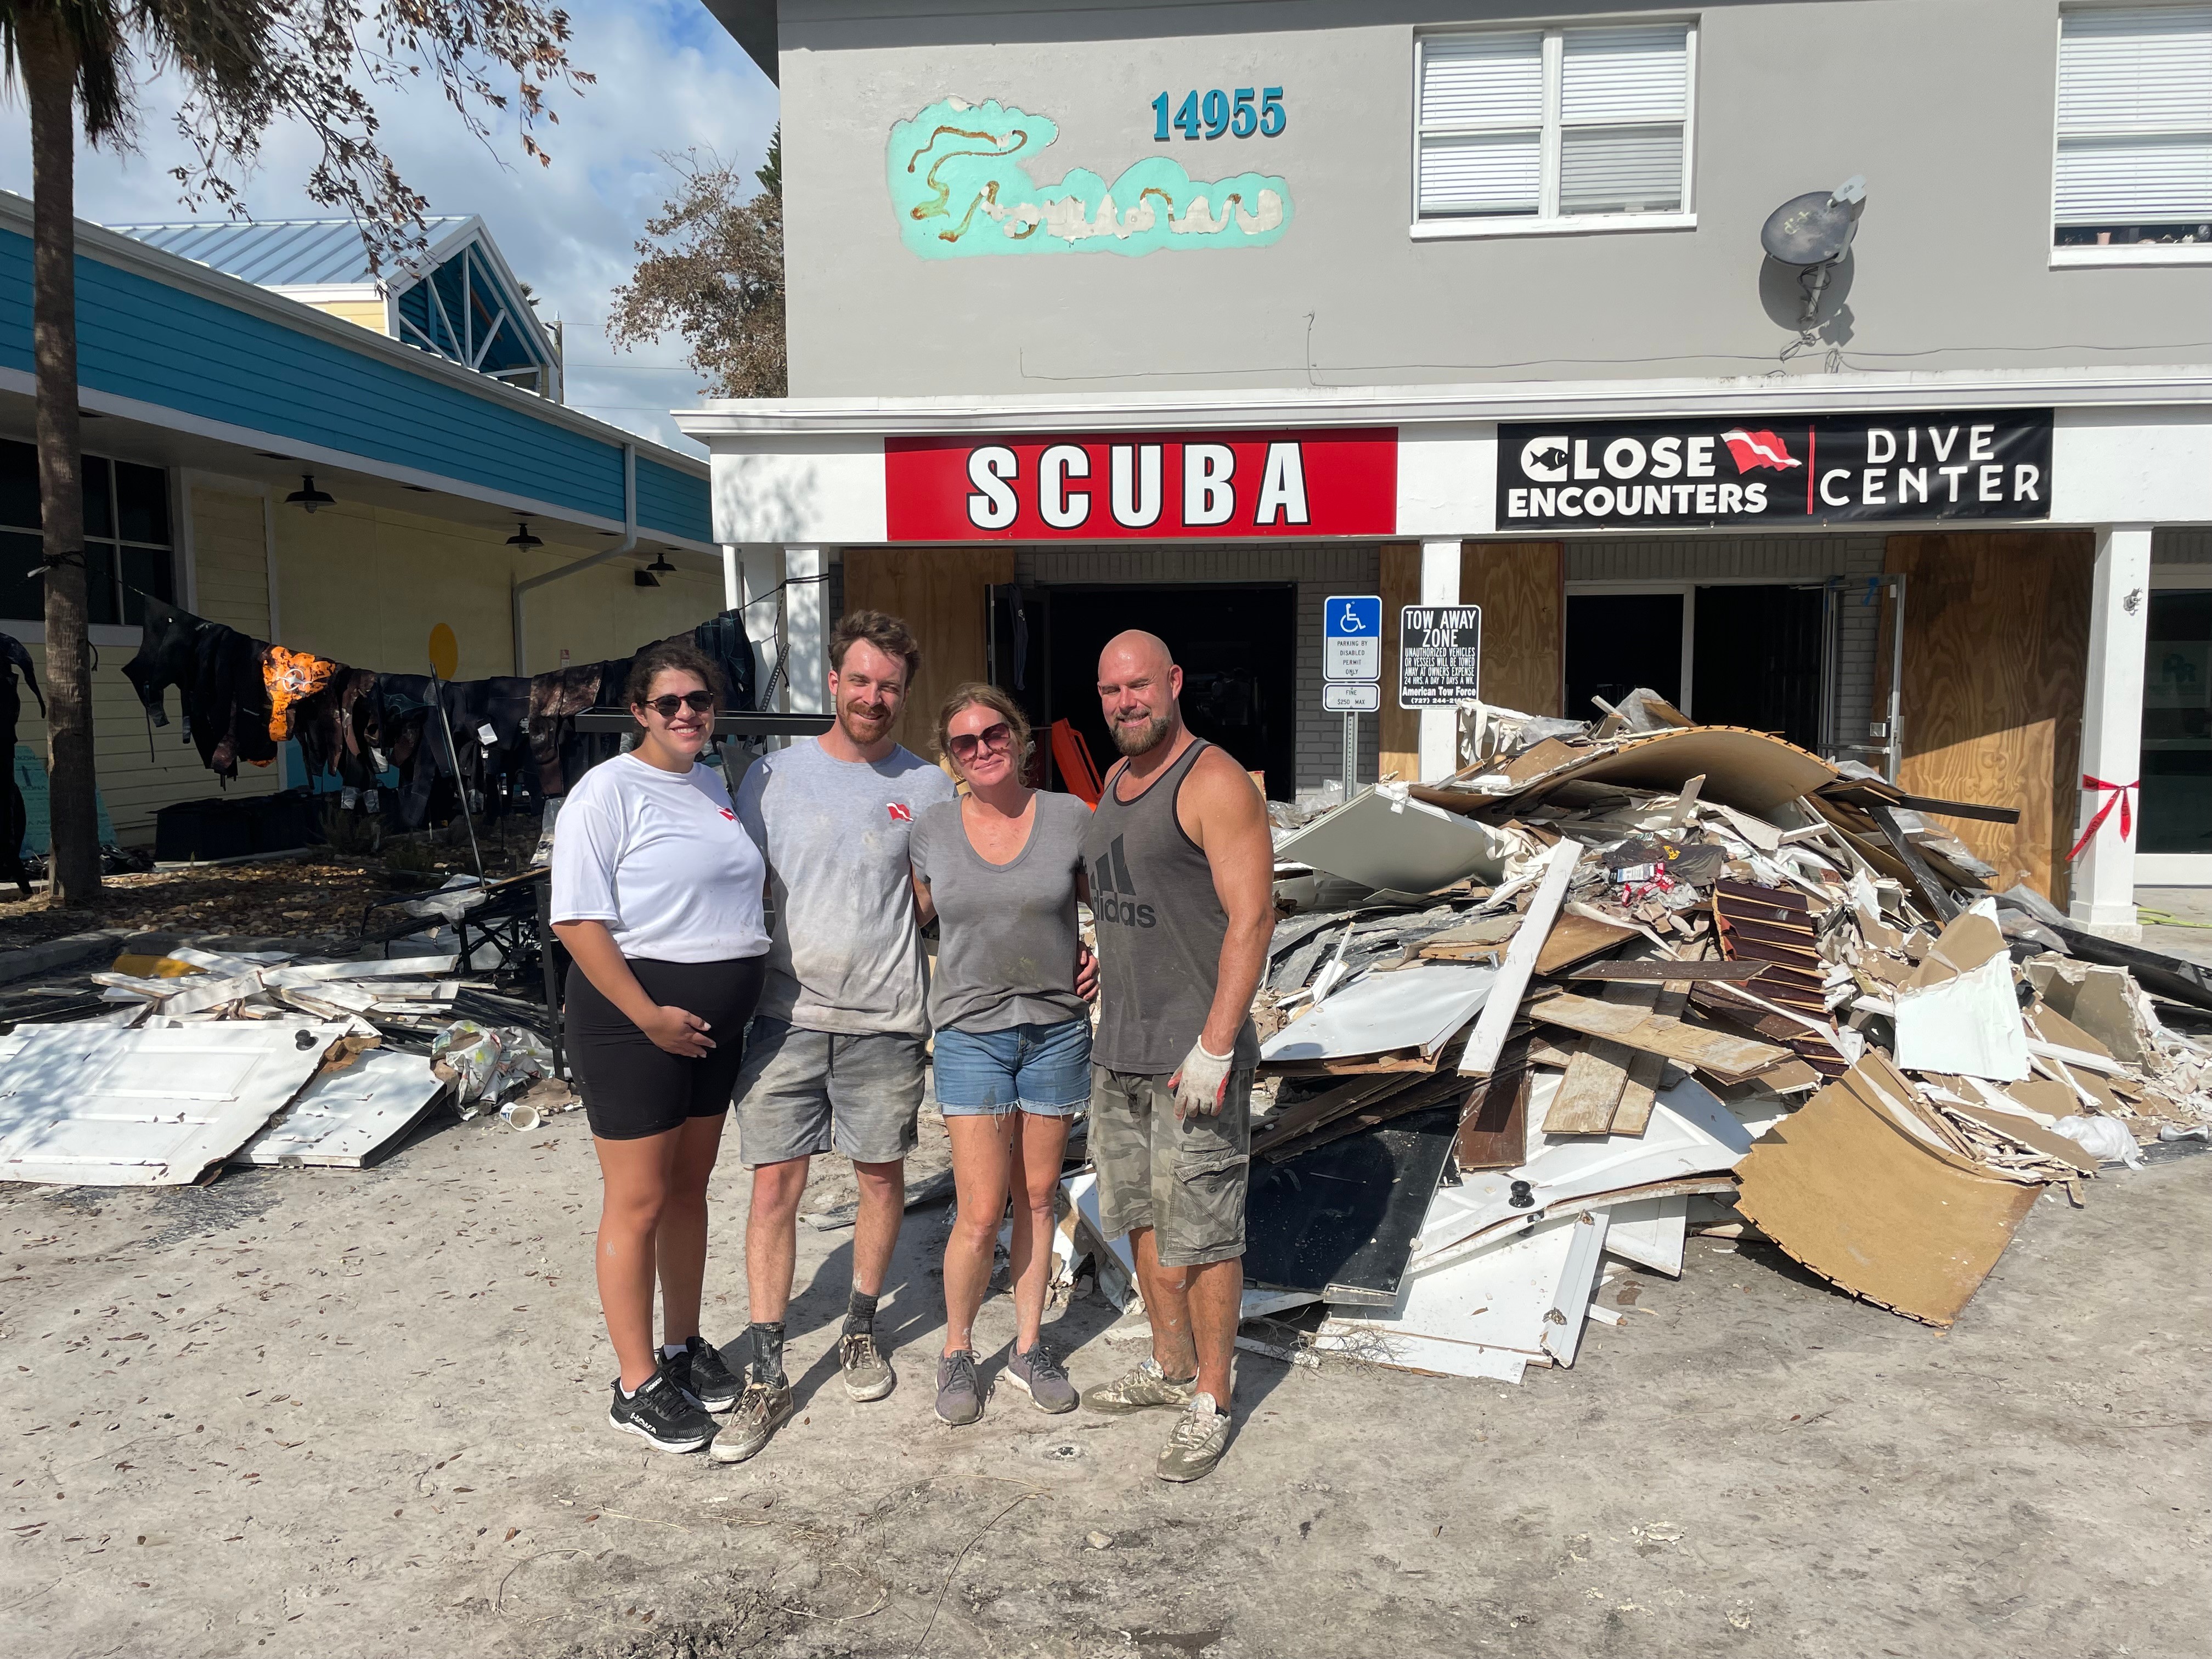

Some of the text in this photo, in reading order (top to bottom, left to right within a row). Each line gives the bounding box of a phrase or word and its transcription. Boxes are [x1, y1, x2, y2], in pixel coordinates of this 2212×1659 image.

[1151, 85, 1287, 142] 14955
[1866, 424, 1995, 464] DIVE
[1520, 435, 1716, 482] CLOSE
[966, 439, 1312, 531] SCUBA
[1819, 464, 2040, 506] CENTER
[1508, 483, 1768, 517] ENCOUNTERS
[1406, 610, 1476, 630] TOW AWAY
[1422, 628, 1458, 647] ZONE
[1404, 647, 1475, 657] UNAUTHORIZED VEHICLES
[1404, 657, 1475, 667] OR VESSELS WILL BE TOWED
[1404, 667, 1475, 676] AWAY AT OWNERS EXPENSE
[1404, 676, 1475, 685] 24 HRS. A DAY 7 DAYS A WK.
[1402, 686, 1476, 696] American Tow Force
[1092, 889, 1156, 928] didas
